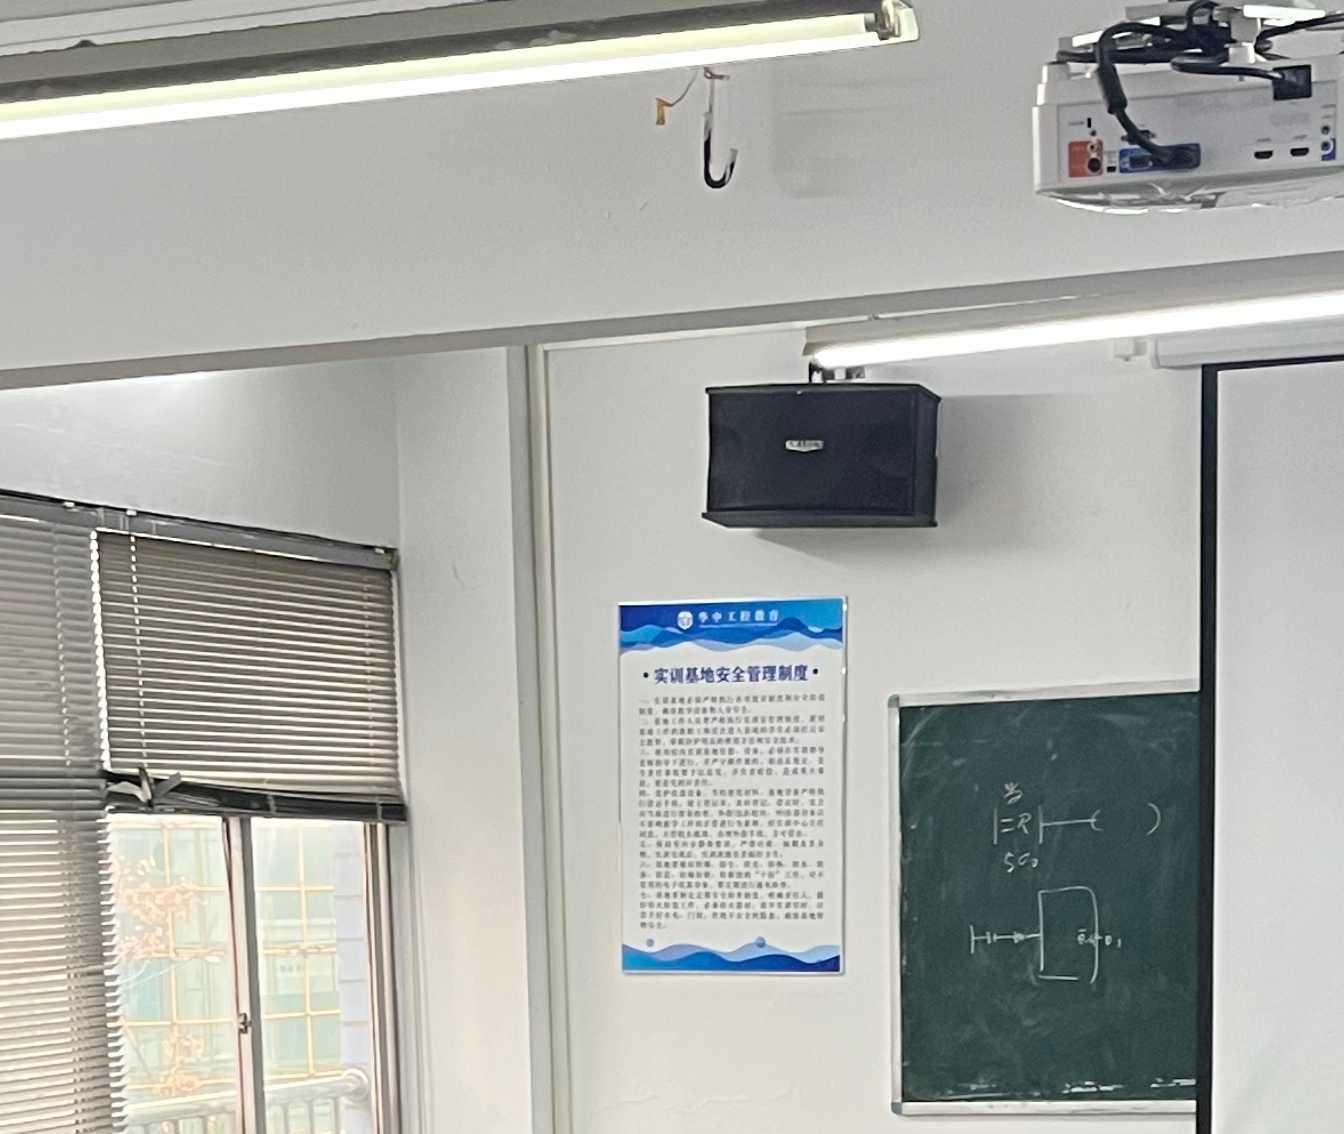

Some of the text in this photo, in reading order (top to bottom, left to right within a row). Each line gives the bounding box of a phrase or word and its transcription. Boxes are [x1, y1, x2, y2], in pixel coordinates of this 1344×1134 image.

[653, 664, 809, 685] 实训基地安全管理制度
